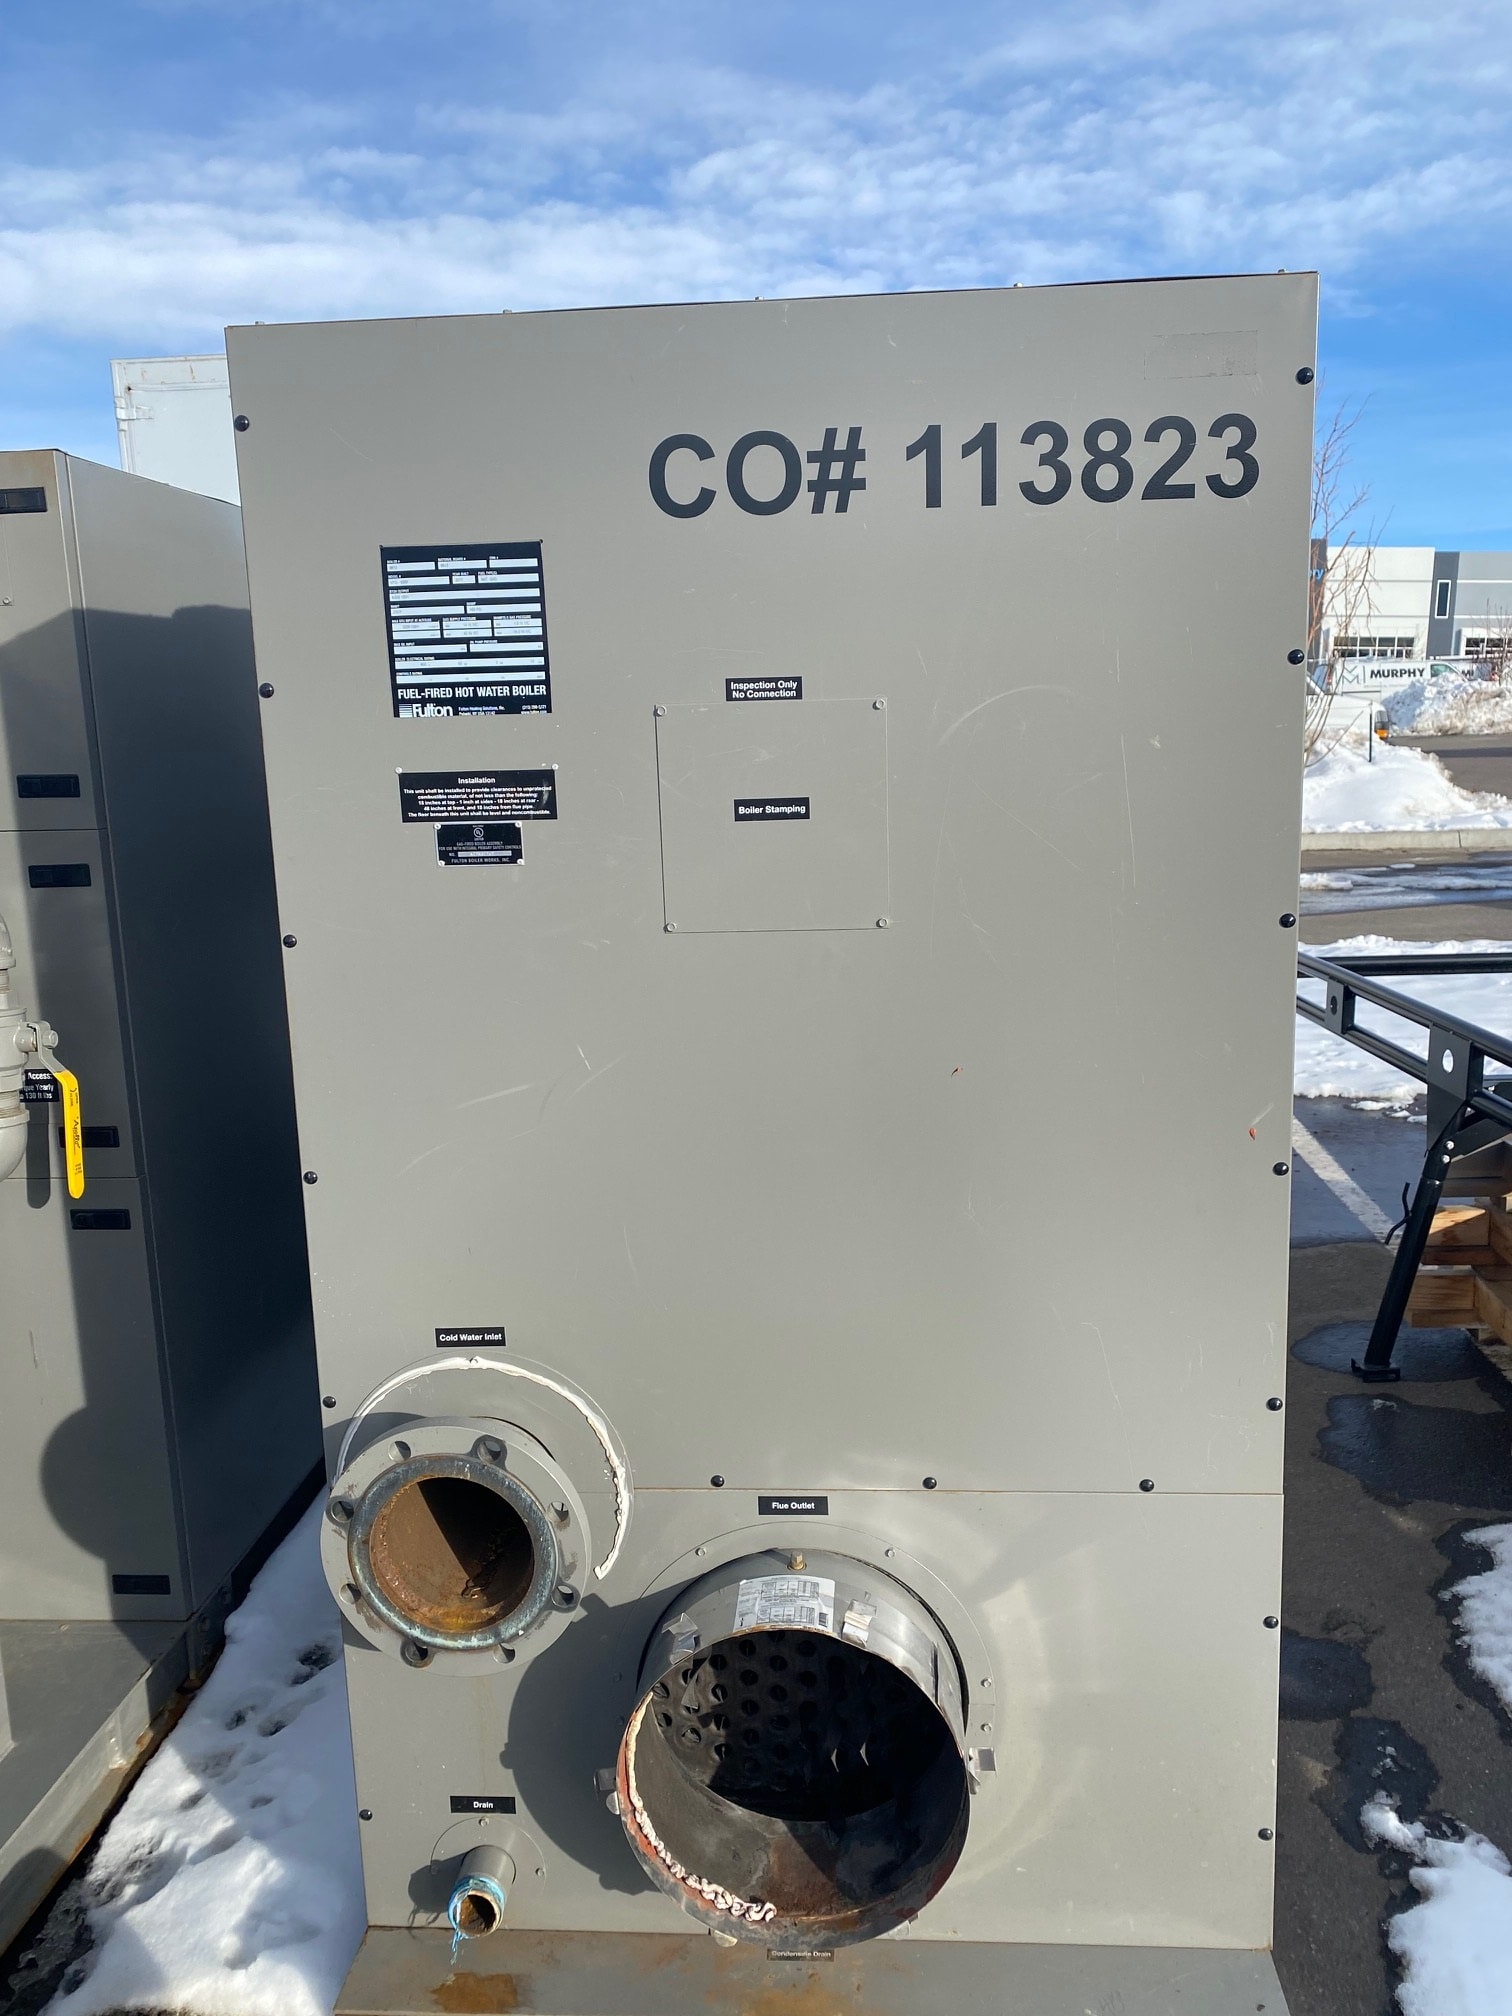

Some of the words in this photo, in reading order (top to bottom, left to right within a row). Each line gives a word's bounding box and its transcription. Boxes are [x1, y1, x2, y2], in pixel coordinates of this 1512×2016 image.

[648, 426, 867, 519] CO#
[904, 412, 1262, 508] 113823
[1370, 668, 1425, 678] MURPHY
[731, 681, 776, 690] Inspection
[777, 680, 798, 689] Only
[397, 687, 453, 699] FUEL-FIRED
[455, 687, 475, 697] HOT
[476, 686, 510, 697] WATER
[512, 685, 547, 696] BOILER
[732, 690, 745, 698] No
[746, 689, 796, 698] Connection
[412, 702, 453, 717] Fulton
[738, 806, 763, 814] Boiler
[765, 804, 806, 814] Stamping
[35, 1083, 54, 1092] Yearly
[459, 1333, 483, 1341] Water
[771, 1501, 789, 1509] Flue
[790, 1501, 815, 1509] Outlet
